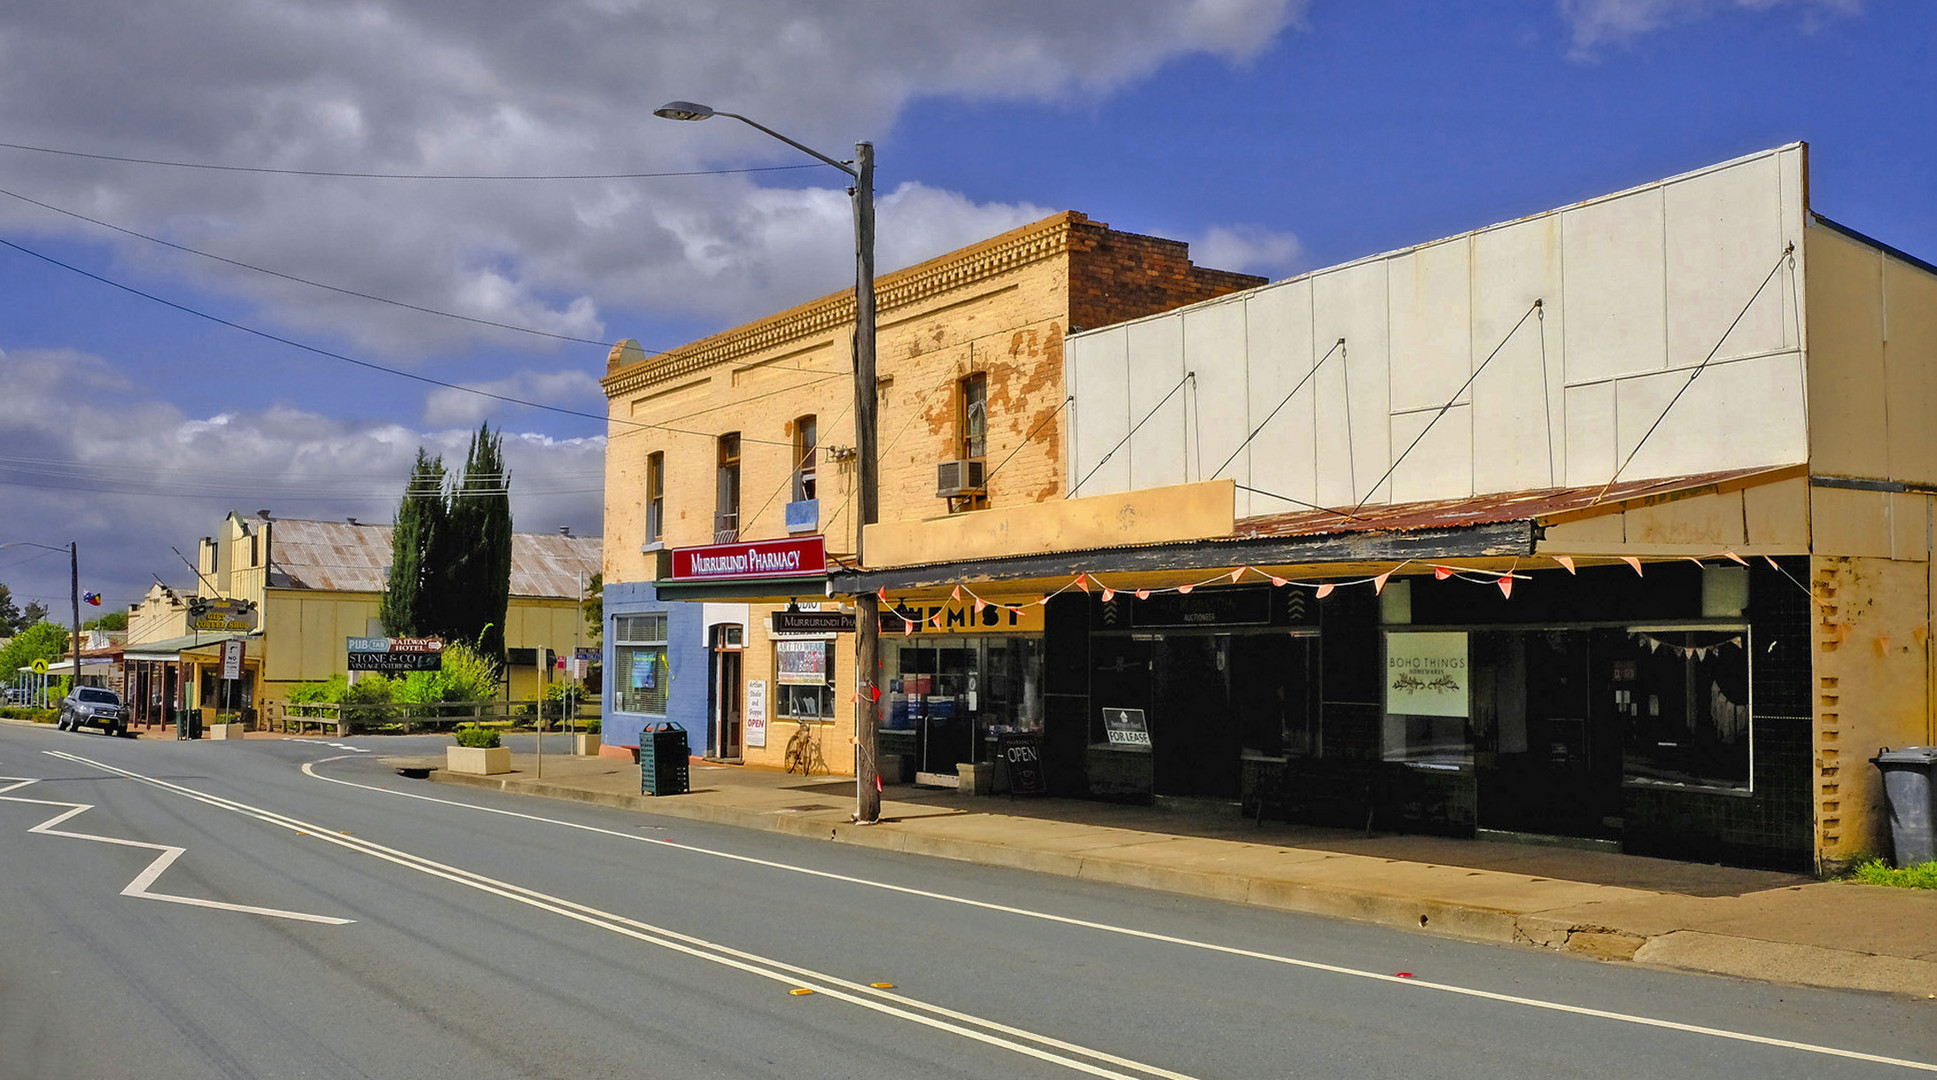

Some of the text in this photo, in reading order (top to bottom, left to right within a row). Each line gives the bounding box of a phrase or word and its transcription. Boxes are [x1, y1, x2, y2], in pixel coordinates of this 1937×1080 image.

[691, 548, 800, 575] MURRURUNDI PHARMACY
[784, 616, 840, 627] MURRURUNDI
[349, 640, 369, 650] PUB
[350, 653, 387, 663] STONE
[389, 653, 397, 662] &
[399, 654, 416, 663] CO
[1390, 657, 1465, 668] BOHO THINGS
[748, 719, 764, 727] OPEN
[1110, 731, 1149, 743] FOR LEASE
[1008, 747, 1037, 762] OPEN
